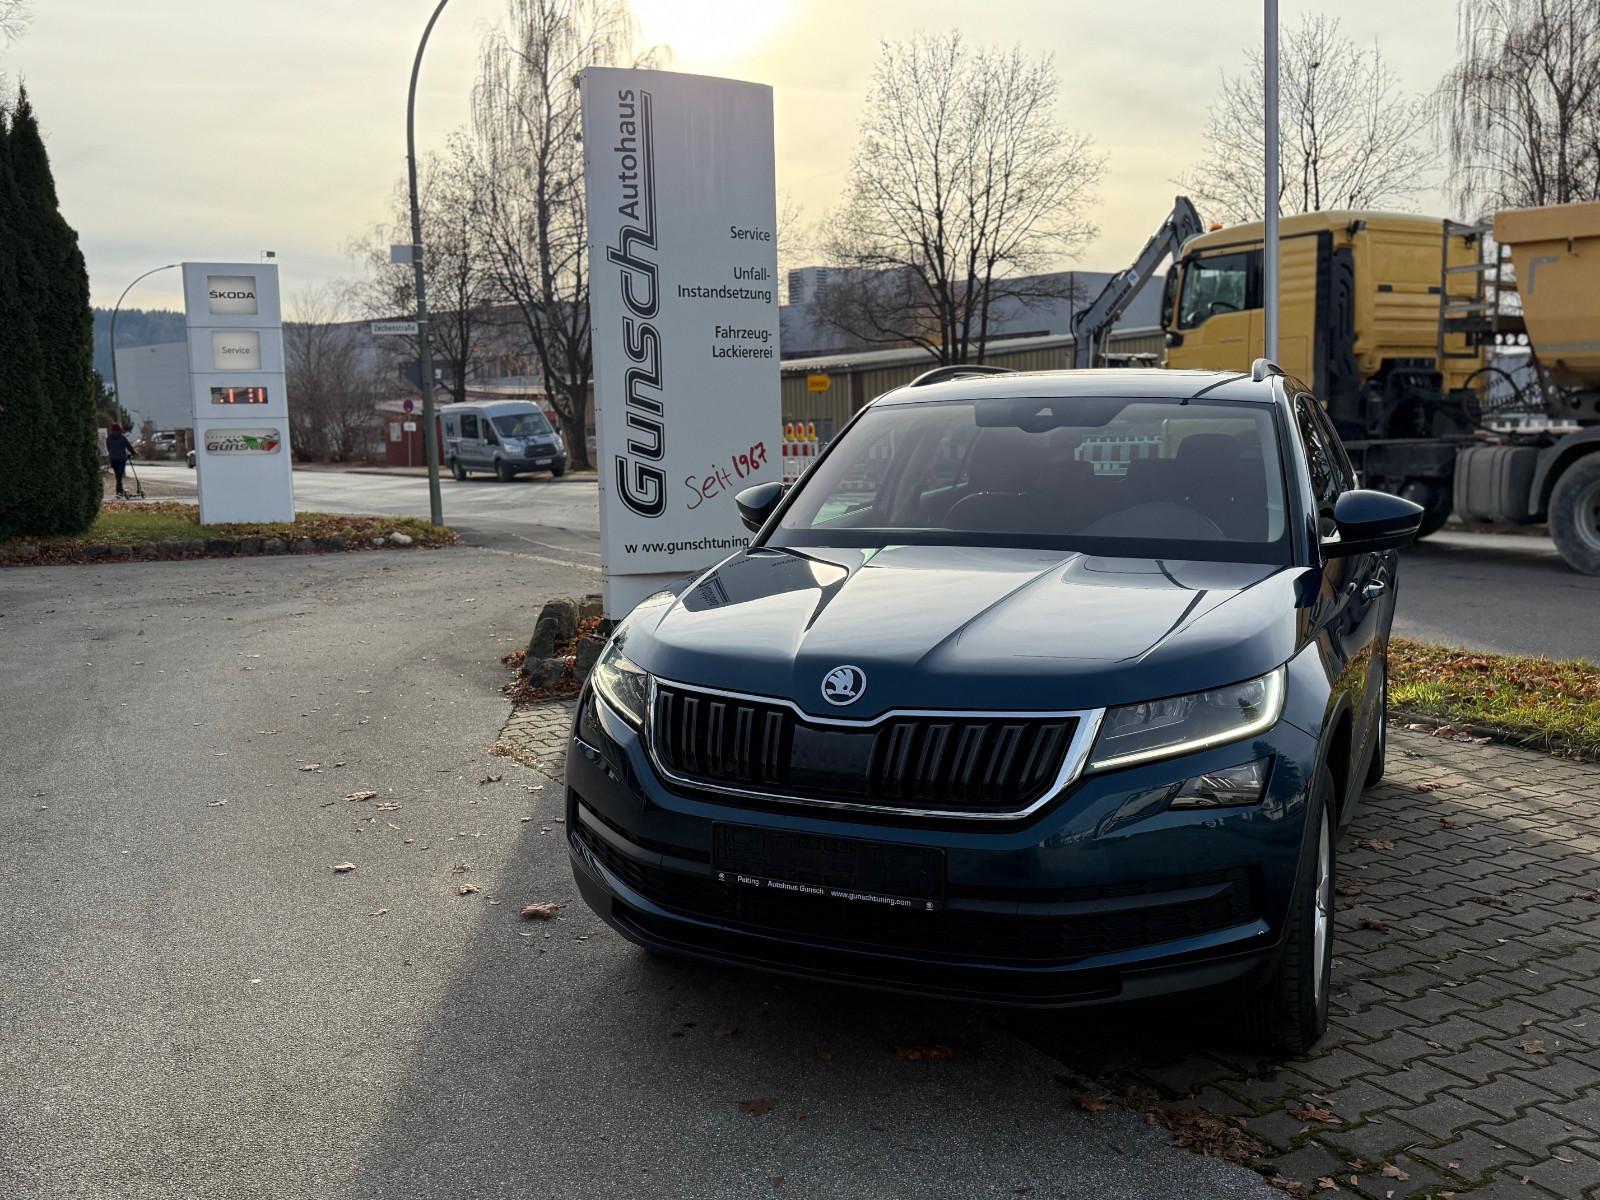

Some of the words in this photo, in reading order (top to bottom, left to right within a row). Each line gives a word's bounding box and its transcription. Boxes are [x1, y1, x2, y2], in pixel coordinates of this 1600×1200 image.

[614, 89, 639, 221] Autohaus
[730, 226, 771, 241] Service
[733, 266, 771, 281] Unfall-
[209, 289, 256, 300] ŠKODA
[677, 284, 772, 304] Instandsetzung
[714, 325, 773, 343] Fahrzeug-
[222, 345, 251, 355] Service
[712, 344, 773, 359] Lackiererei
[607, 224, 667, 518] Gunsch
[685, 464, 733, 510] Seit
[732, 441, 768, 479] 1967
[767, 880, 799, 891] Autohaus
[799, 885, 824, 895] Gunsch
[830, 890, 912, 906] www.gunschtuning.com
